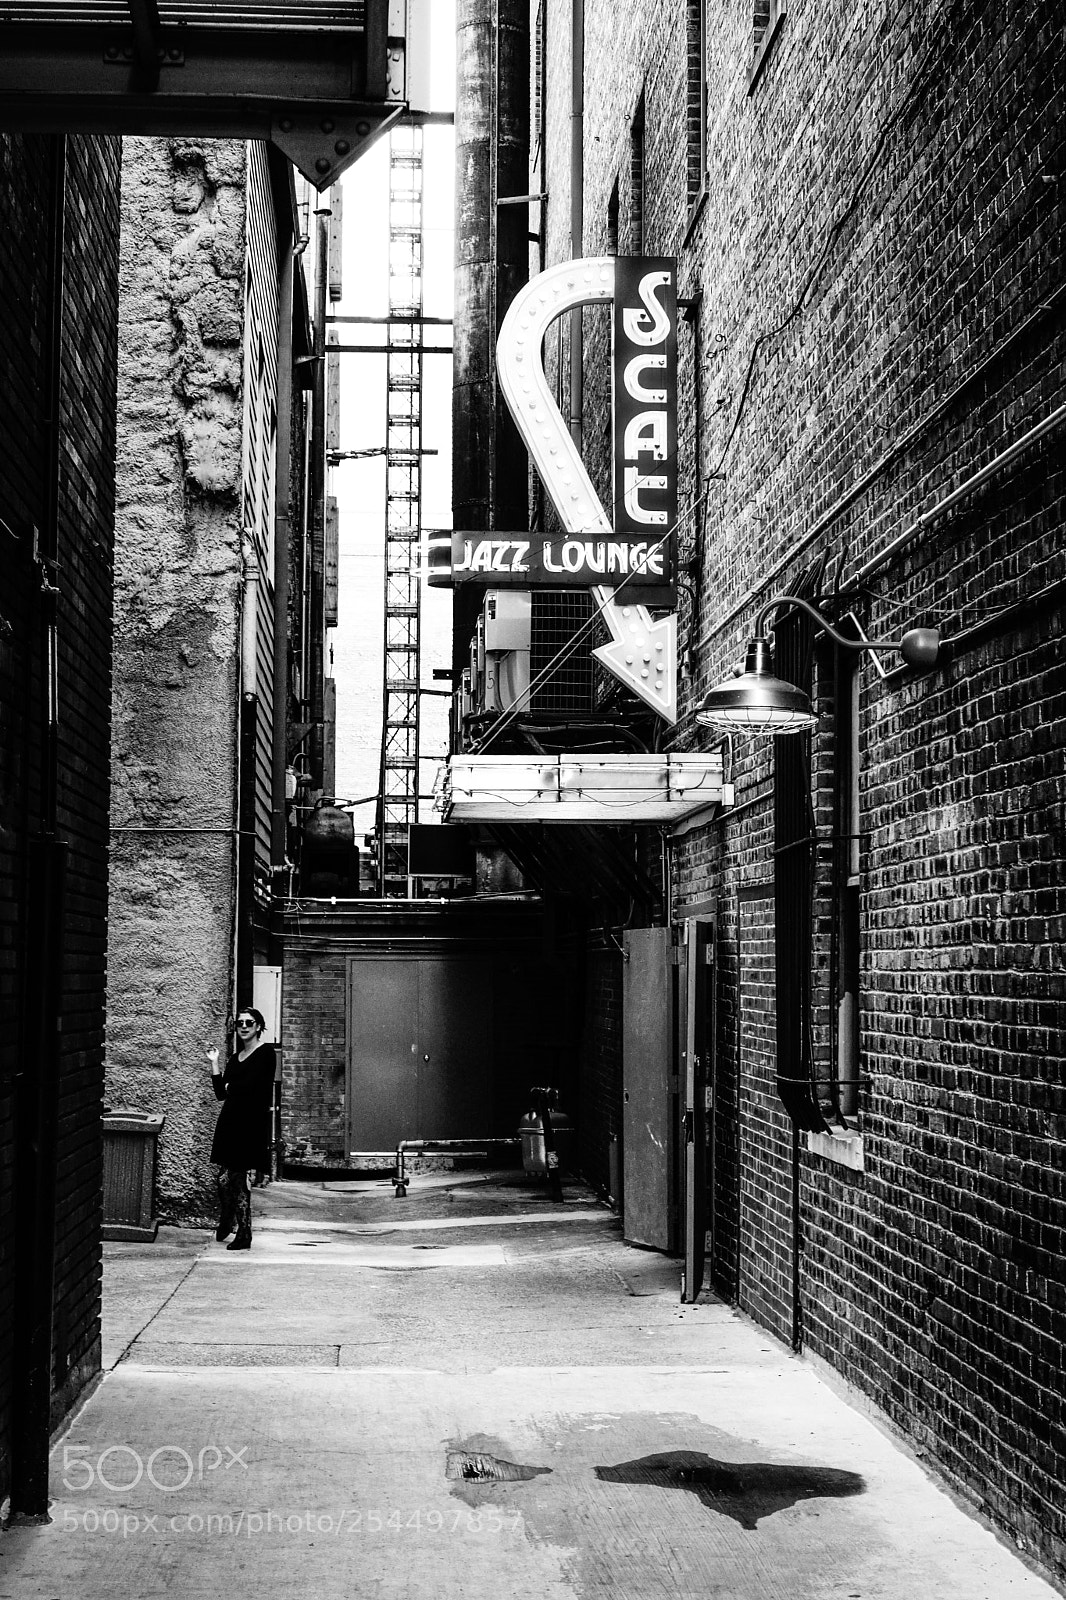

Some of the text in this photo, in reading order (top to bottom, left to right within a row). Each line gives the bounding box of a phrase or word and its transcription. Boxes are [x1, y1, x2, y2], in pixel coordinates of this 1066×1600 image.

[453, 540, 664, 576] JAZZ LOUNGE
[486, 670, 495, 690] 5
